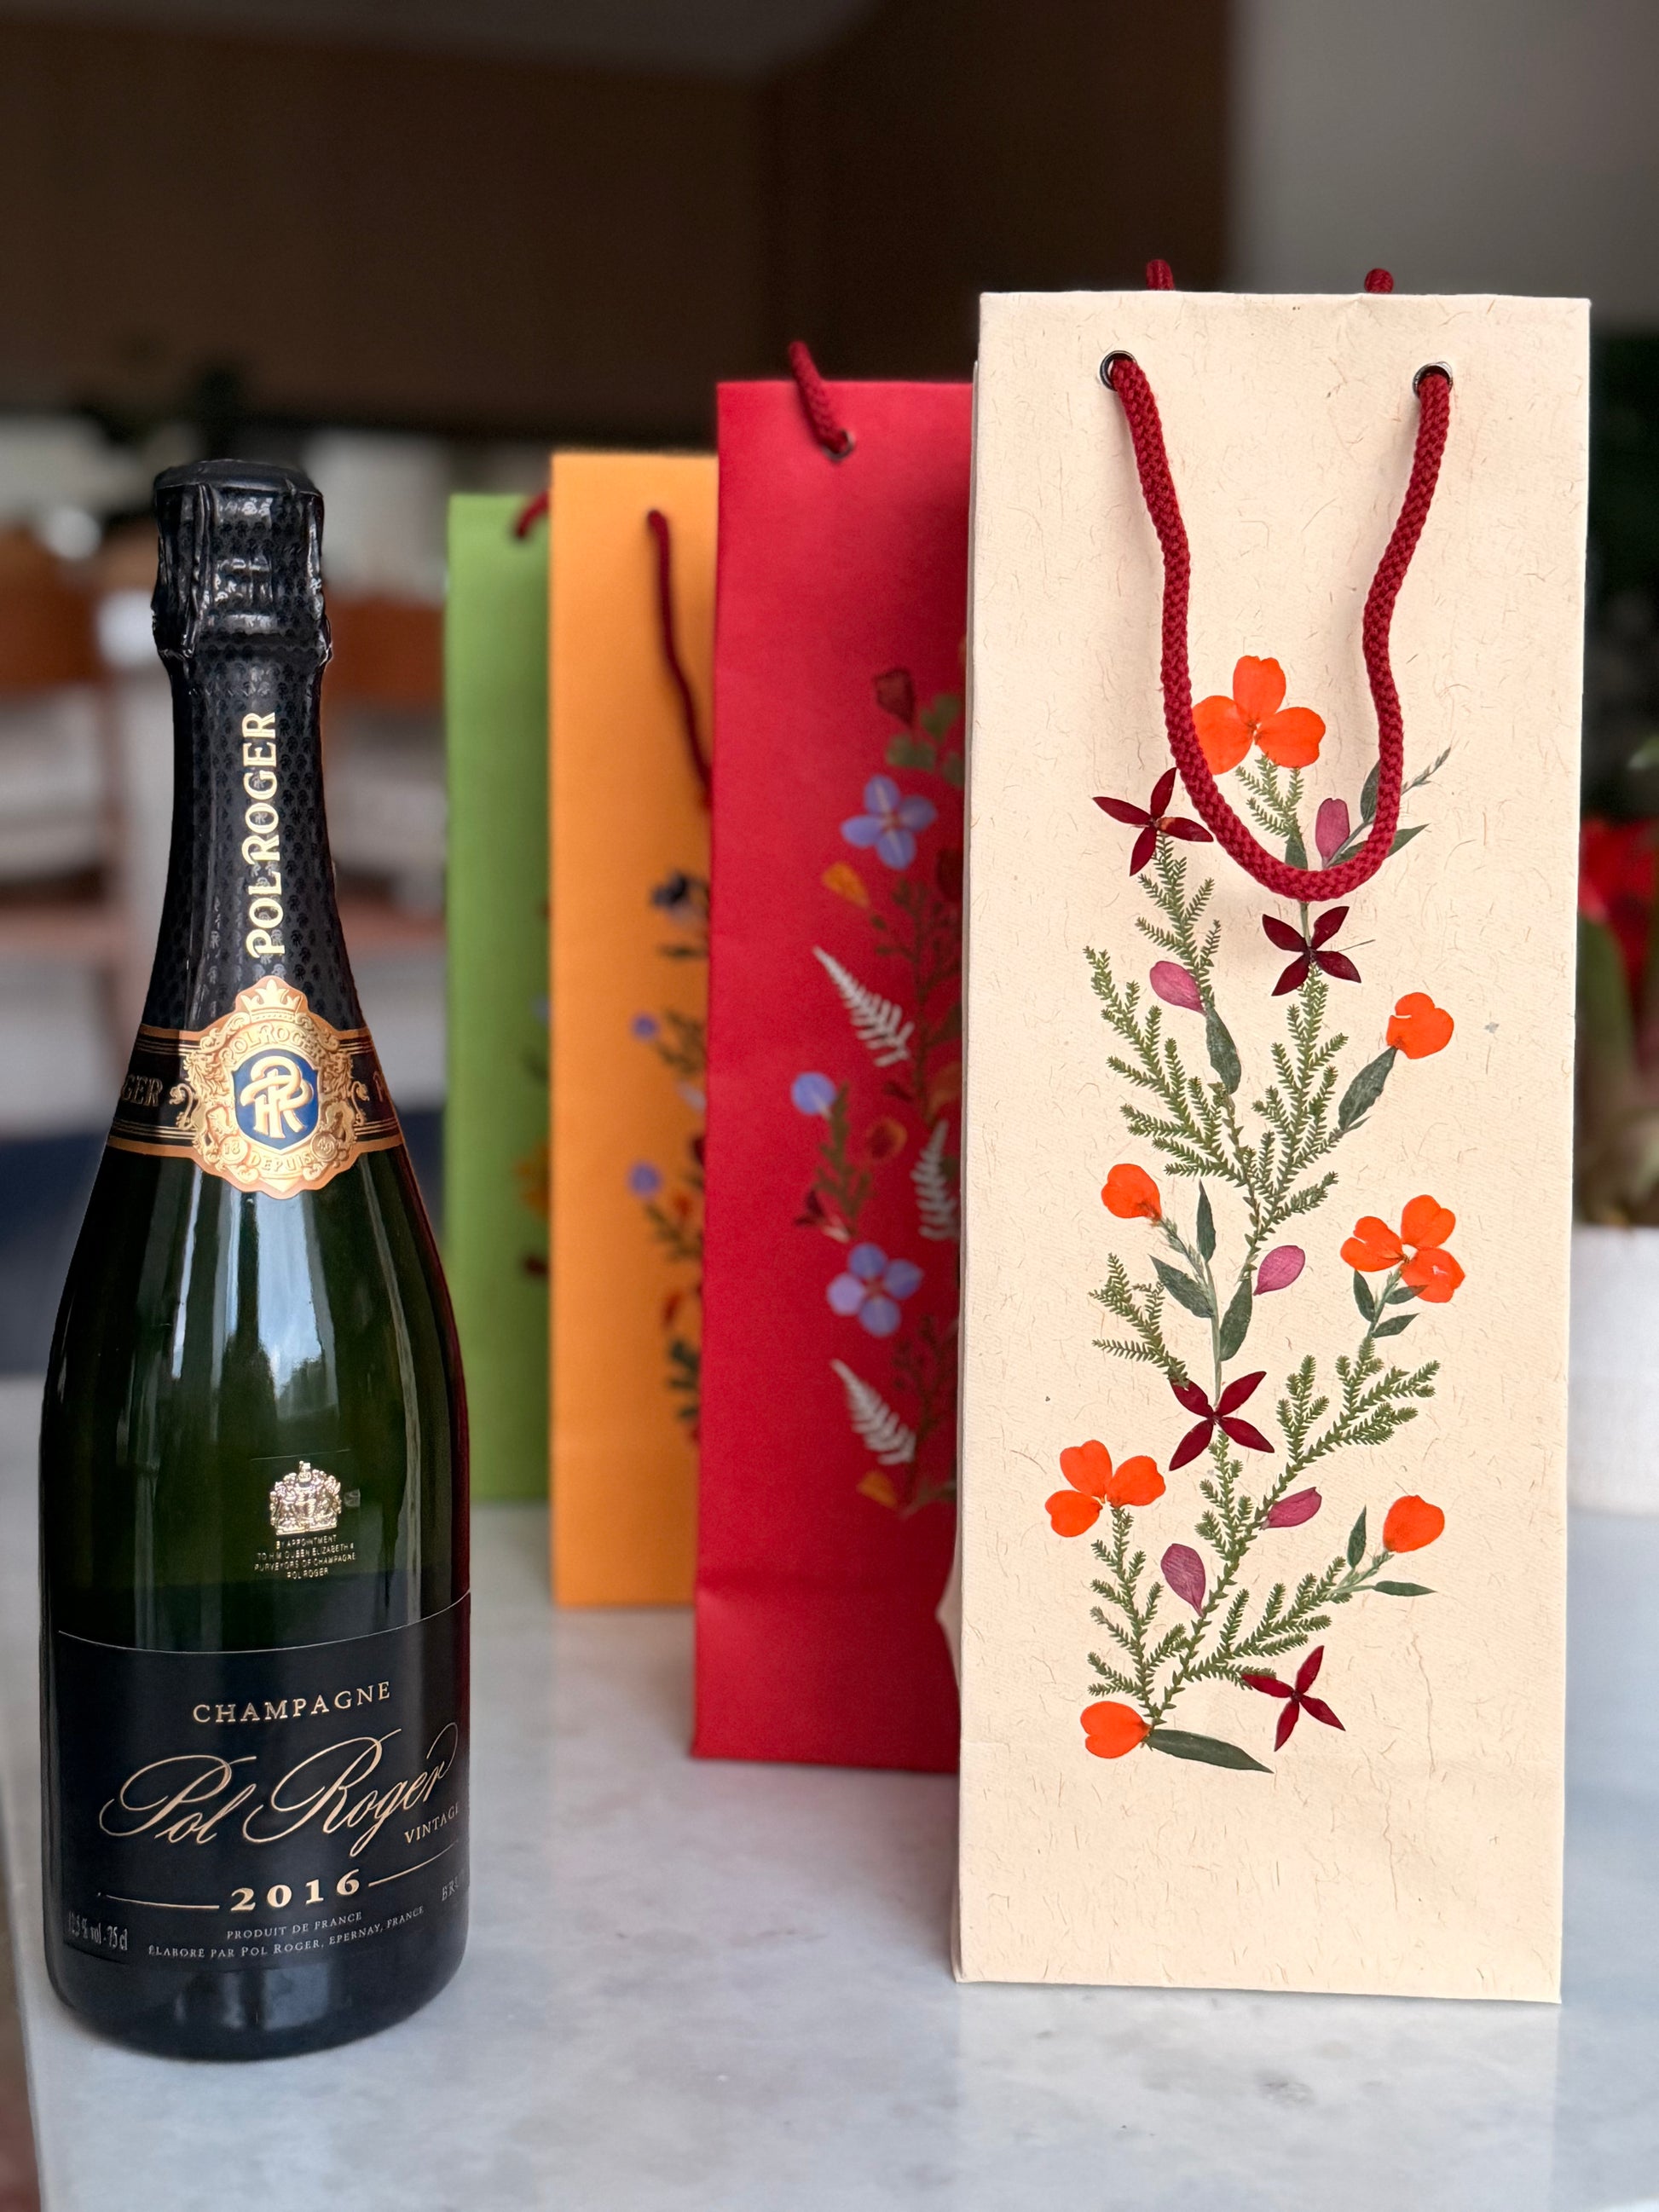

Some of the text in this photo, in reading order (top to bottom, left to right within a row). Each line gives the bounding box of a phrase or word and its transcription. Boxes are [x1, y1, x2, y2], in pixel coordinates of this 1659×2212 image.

[241, 712, 285, 958] POL ROGER
[219, 1022, 327, 1066] POL ROGER
[247, 1149, 314, 1172] DEPUIS
[312, 1543, 349, 1556] ELIZABETH
[313, 1551, 356, 1567] CHAMPAGNE
[303, 1567, 329, 1578] ROGER
[194, 1681, 390, 1724] CHAMPAGNE
[99, 1722, 459, 1858] Pol Roger
[230, 1868, 361, 1912] 2016
[210, 1948, 235, 1959] PAR
[240, 1946, 268, 1958] POL
[273, 1938, 325, 1955] ROGER,
[386, 1905, 425, 1928] FRANCE
[227, 1911, 362, 1940] PRODUIT DE FRANCE
